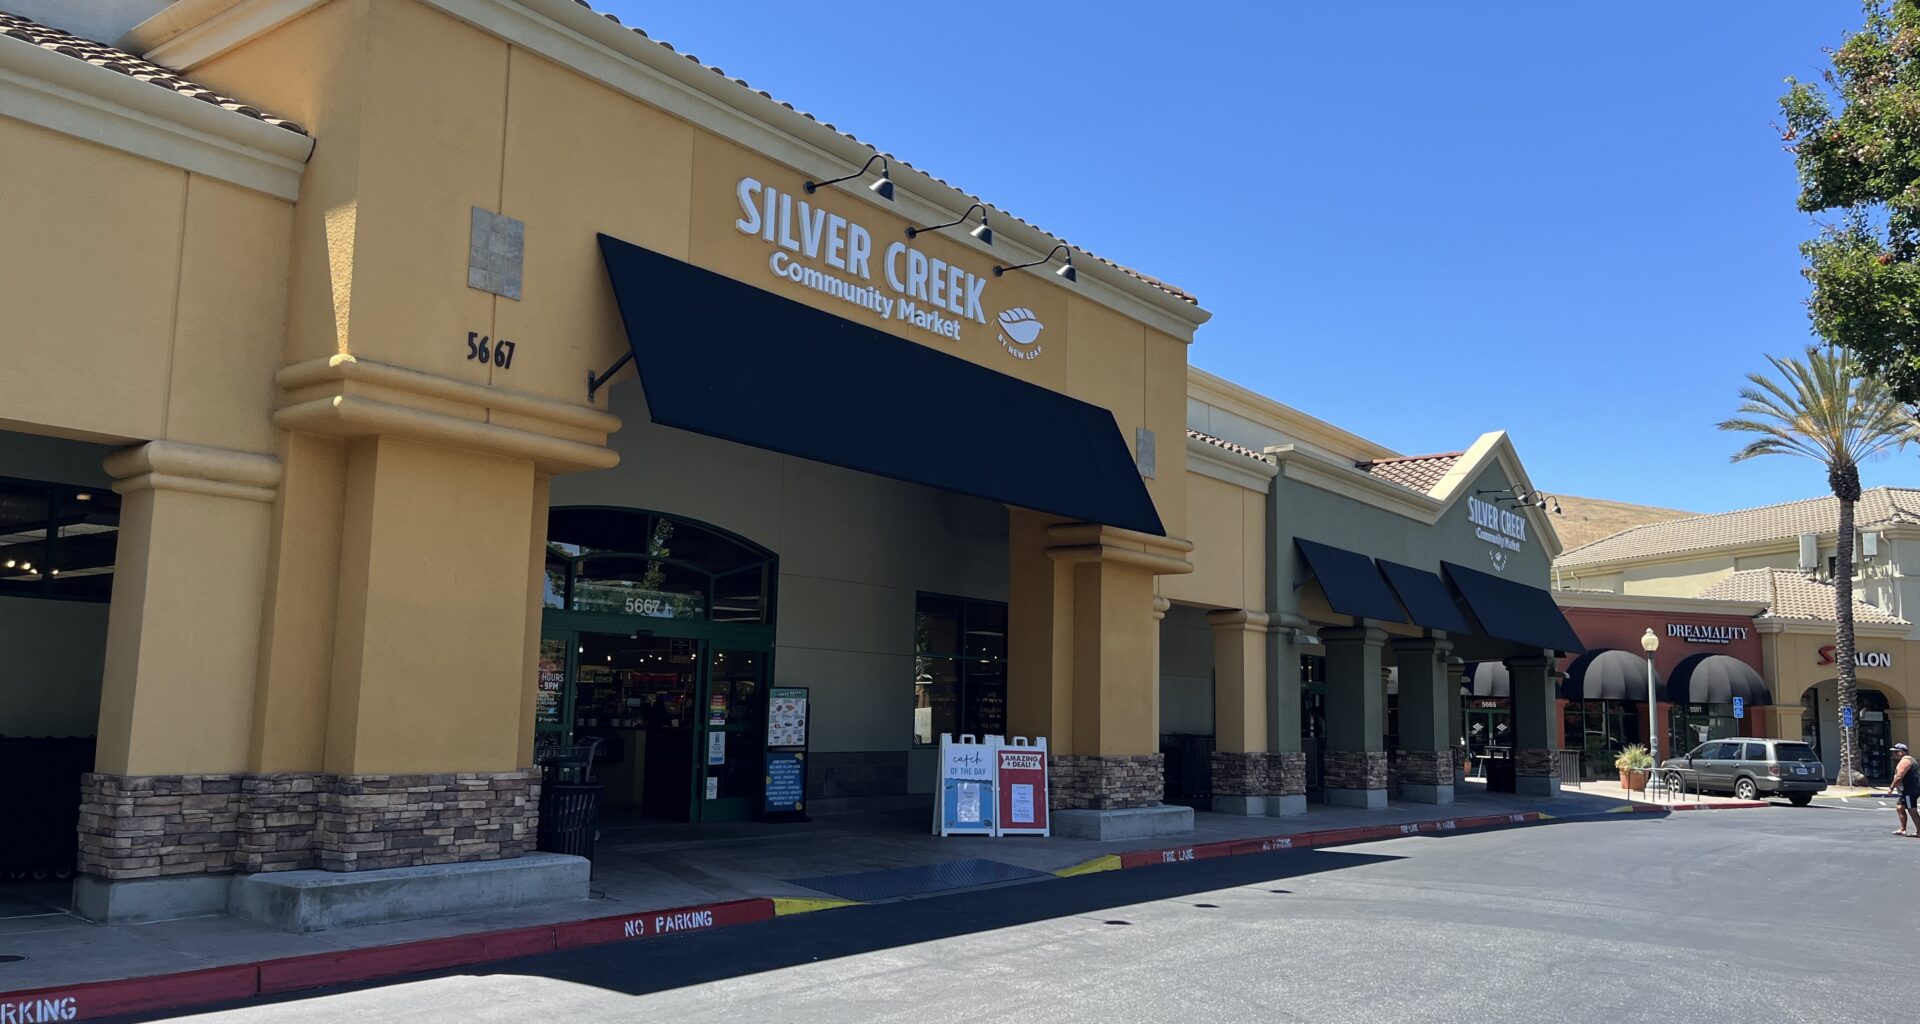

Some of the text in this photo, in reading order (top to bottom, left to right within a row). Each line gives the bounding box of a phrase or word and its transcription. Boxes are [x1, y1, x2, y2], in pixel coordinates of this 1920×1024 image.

[736, 177, 986, 325] SILVER CREEK
[769, 252, 960, 340] Community Market
[467, 332, 515, 370] 5667
[997, 333, 1042, 360] BY NEW LEAF
[1467, 496, 1526, 541] SILVER CREEK
[625, 597, 661, 614] 5667
[1667, 624, 1748, 639] DREAMALITY
[542, 672, 564, 681] HOURS
[544, 682, 558, 690] 9PM
[953, 751, 984, 767] catch
[974, 768, 986, 776] DAY
[1163, 849, 1194, 863] FIRE LANE
[624, 910, 713, 937] NO PARKING
